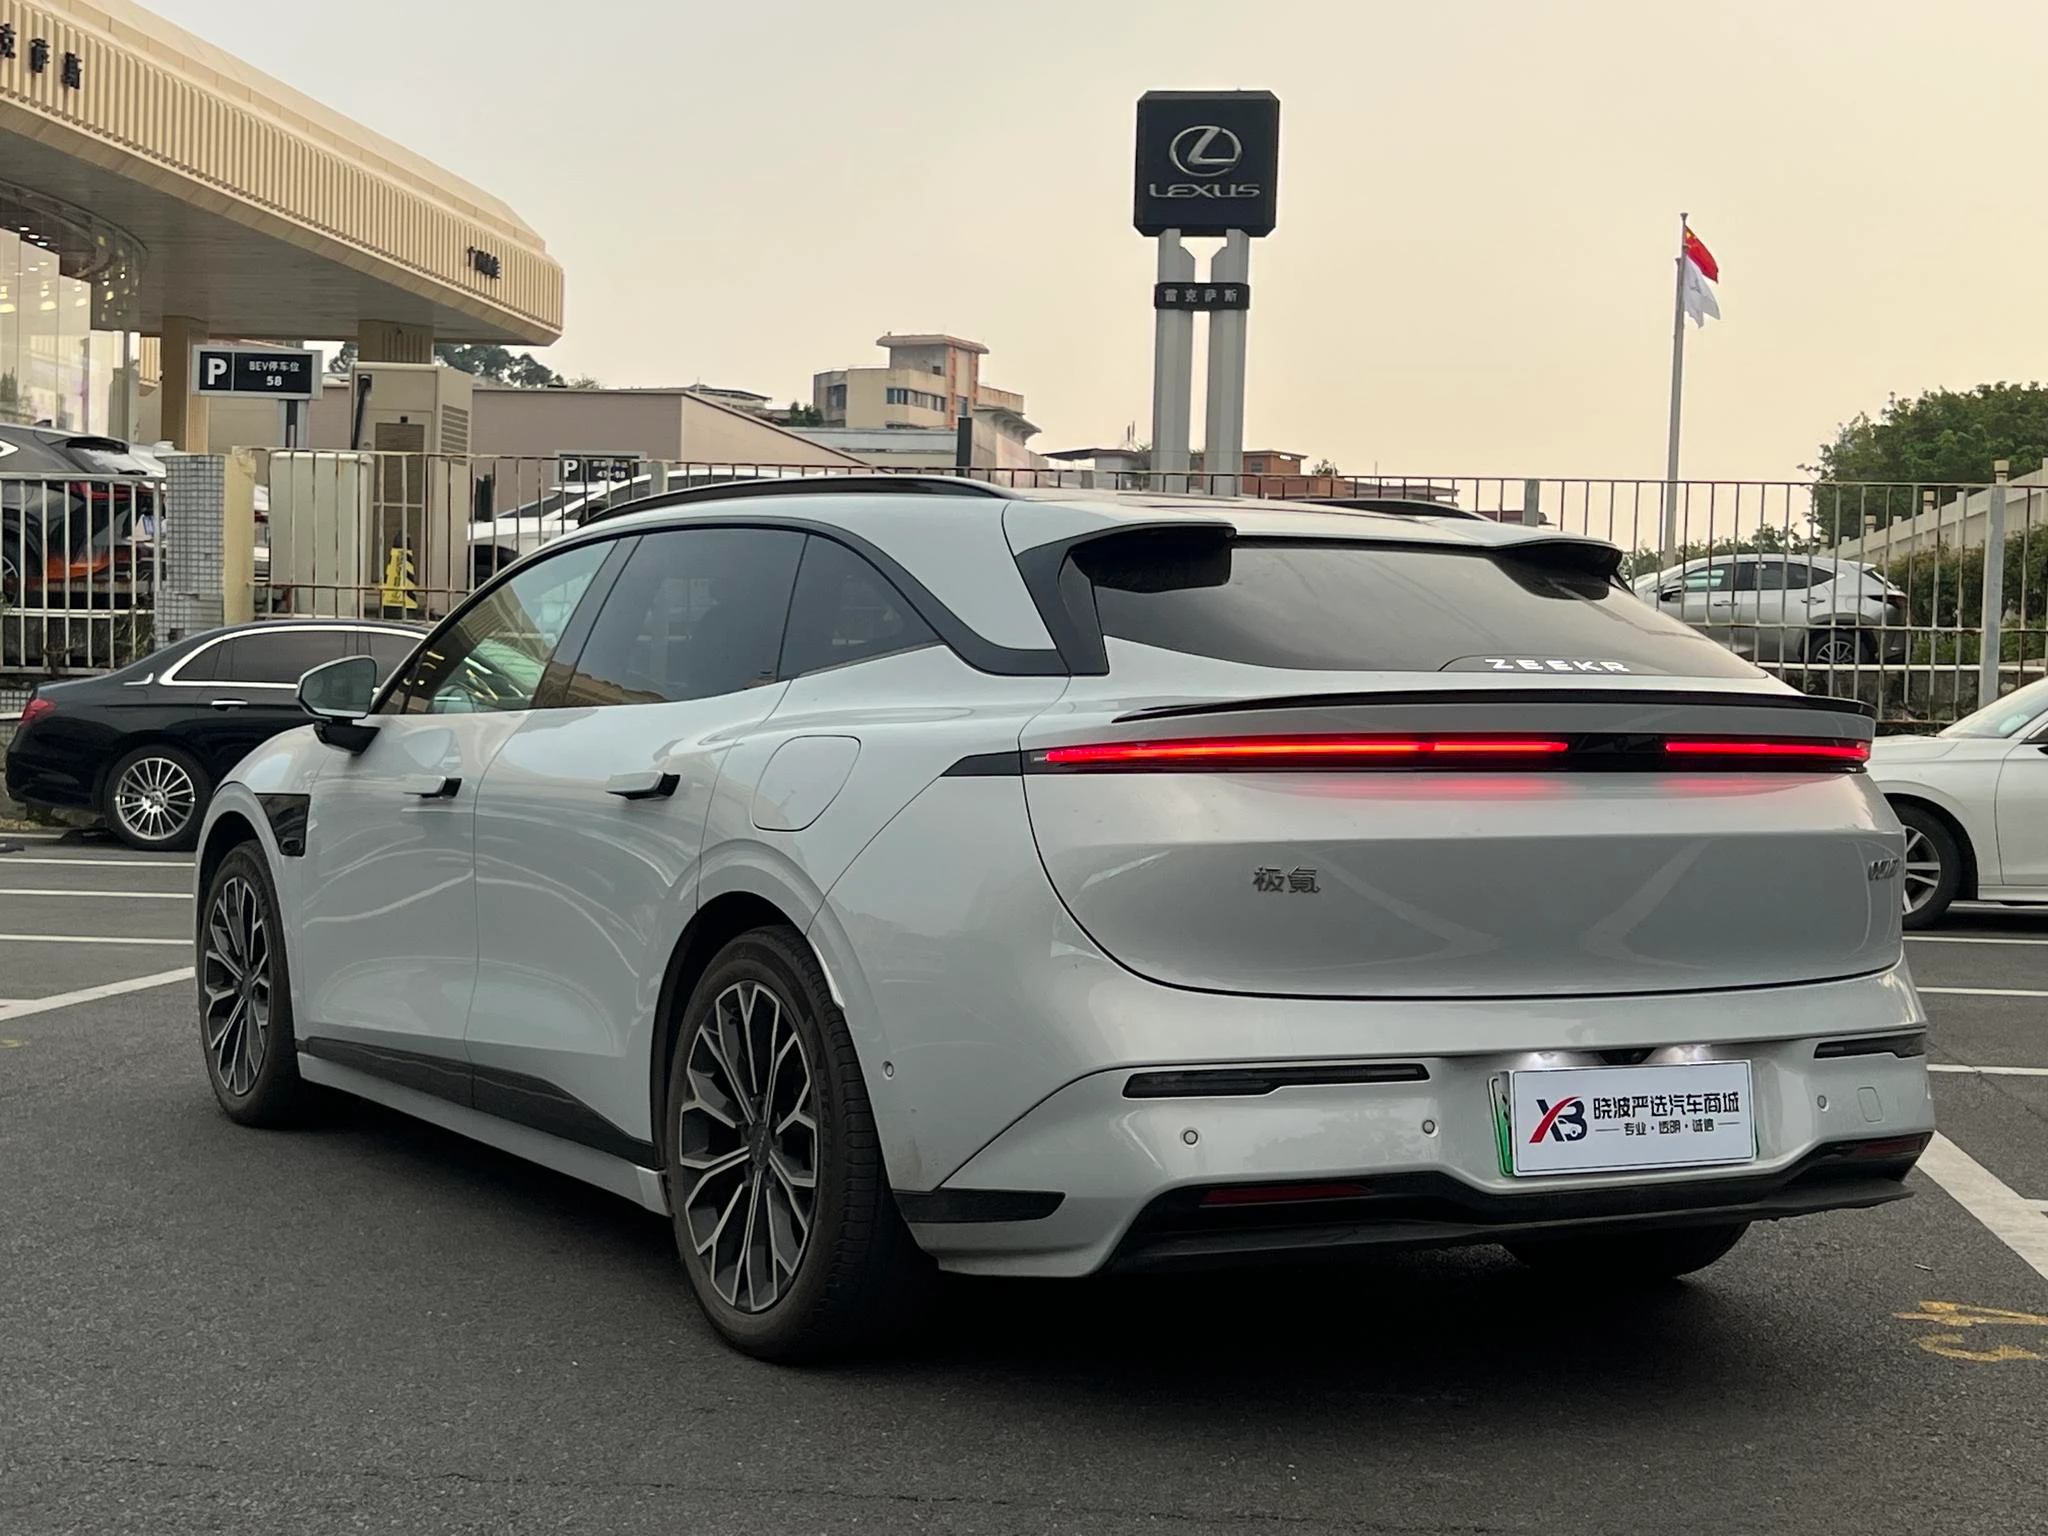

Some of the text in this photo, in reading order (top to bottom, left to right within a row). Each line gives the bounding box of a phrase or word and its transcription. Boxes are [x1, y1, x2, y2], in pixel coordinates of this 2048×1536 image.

[1149, 183, 1261, 198] LEXUS
[1164, 288, 1238, 303] 雷克萨斯
[207, 357, 228, 386] P
[265, 375, 283, 387] 58
[563, 459, 579, 478] P
[1485, 658, 1630, 673] ZEEKR
[1592, 1091, 1740, 1120] 晓波严选汽车商城
